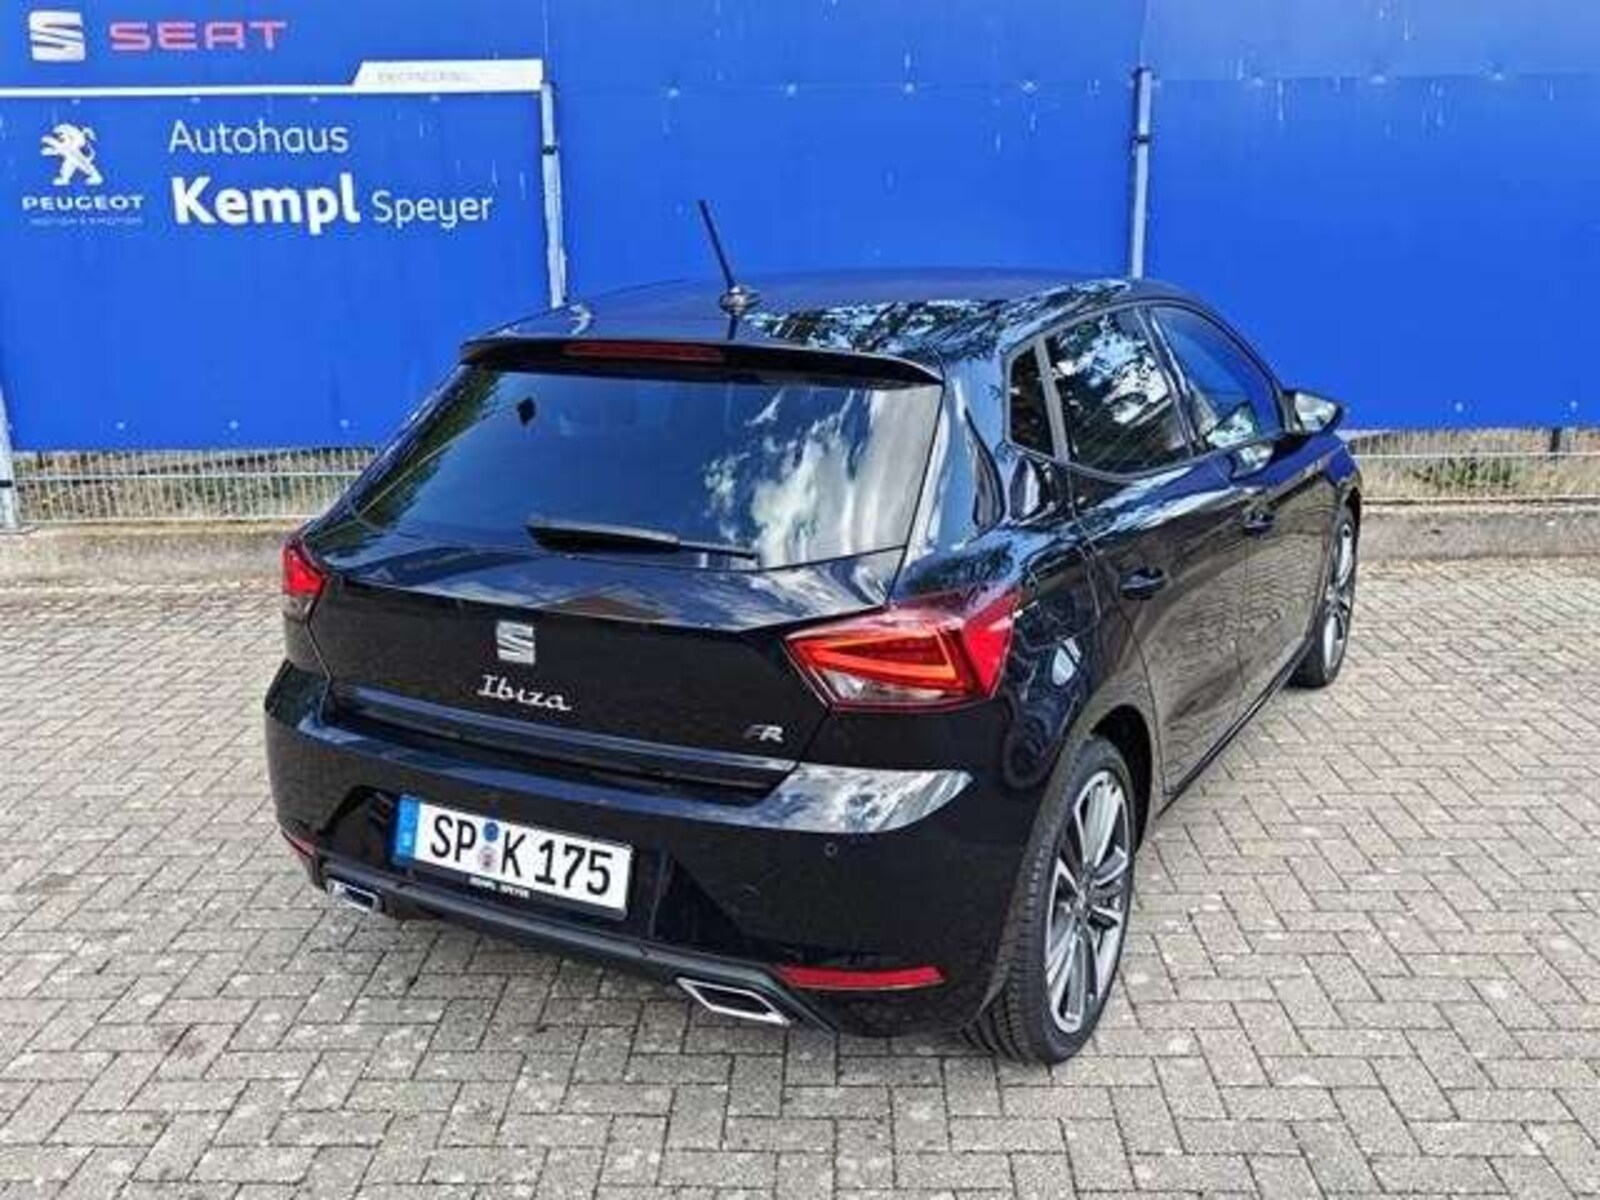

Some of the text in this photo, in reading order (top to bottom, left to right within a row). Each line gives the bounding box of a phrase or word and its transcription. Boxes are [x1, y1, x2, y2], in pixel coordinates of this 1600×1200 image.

[110, 20, 287, 51] SEAT
[168, 120, 350, 154] Autohaus
[22, 195, 144, 211] PEUGEOT
[172, 173, 494, 235] Kempl Speyer
[477, 674, 572, 711] Ibiza
[431, 814, 477, 862] SP
[501, 829, 526, 878] K
[534, 839, 612, 896] 175
